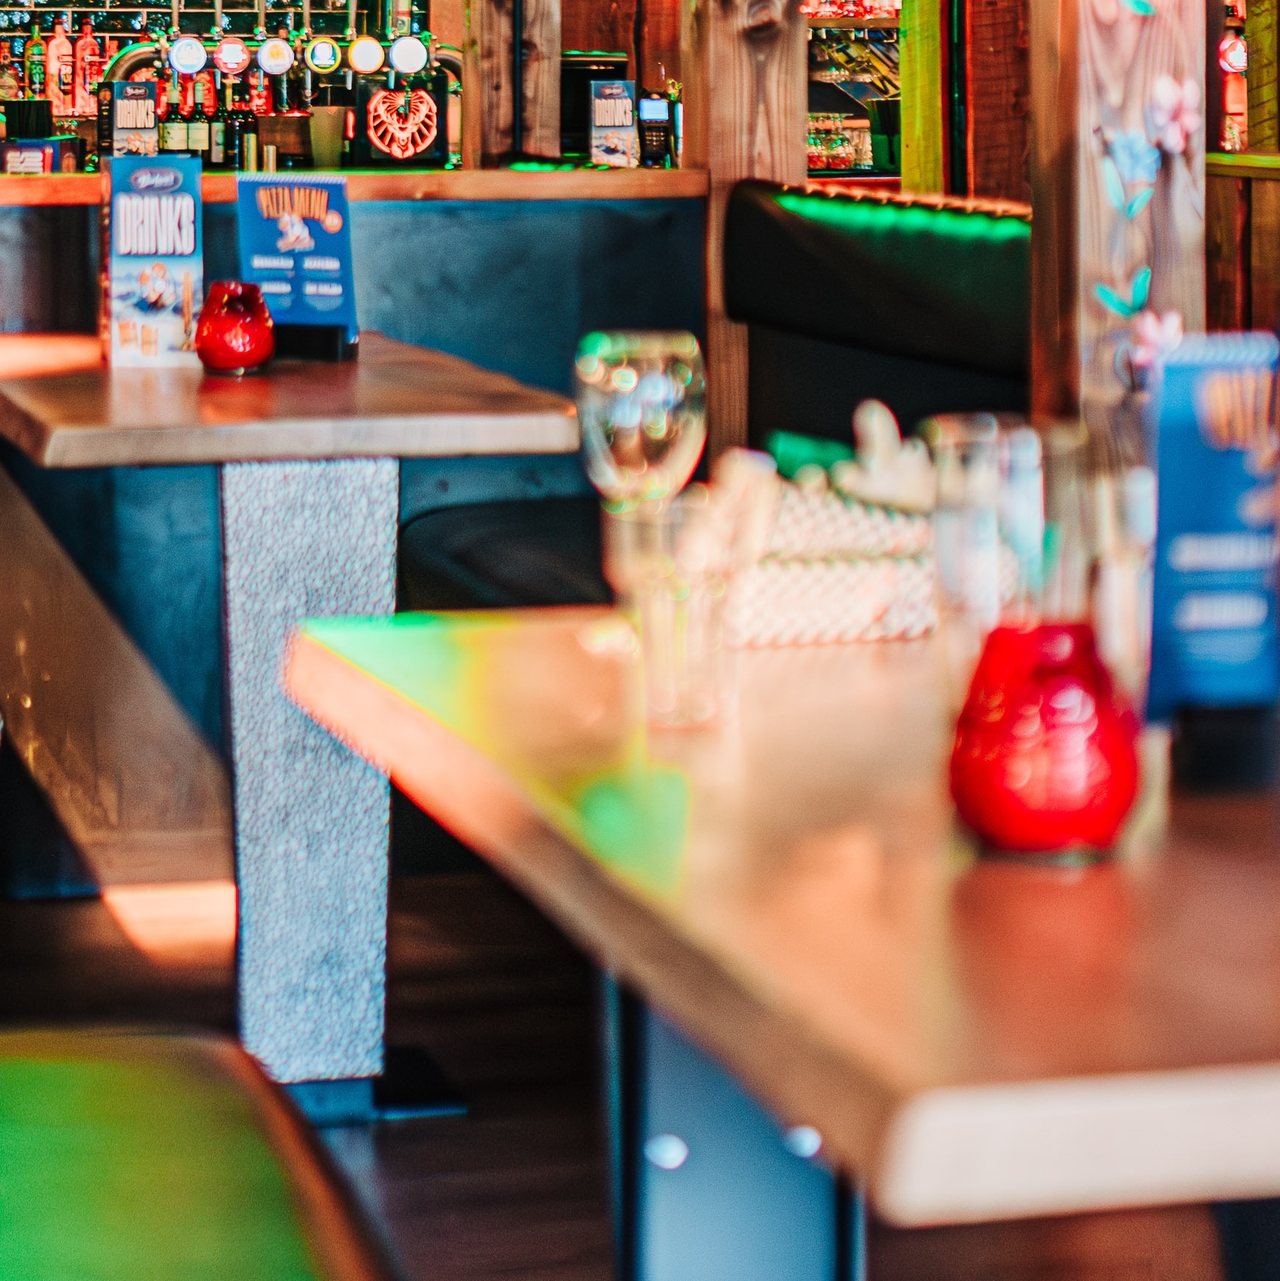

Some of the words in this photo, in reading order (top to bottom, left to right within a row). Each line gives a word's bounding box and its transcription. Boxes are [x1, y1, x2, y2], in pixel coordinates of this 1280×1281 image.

[116, 99, 155, 128] DRINKS
[593, 98, 632, 127] DRINKS
[118, 192, 195, 255] DRINKS
